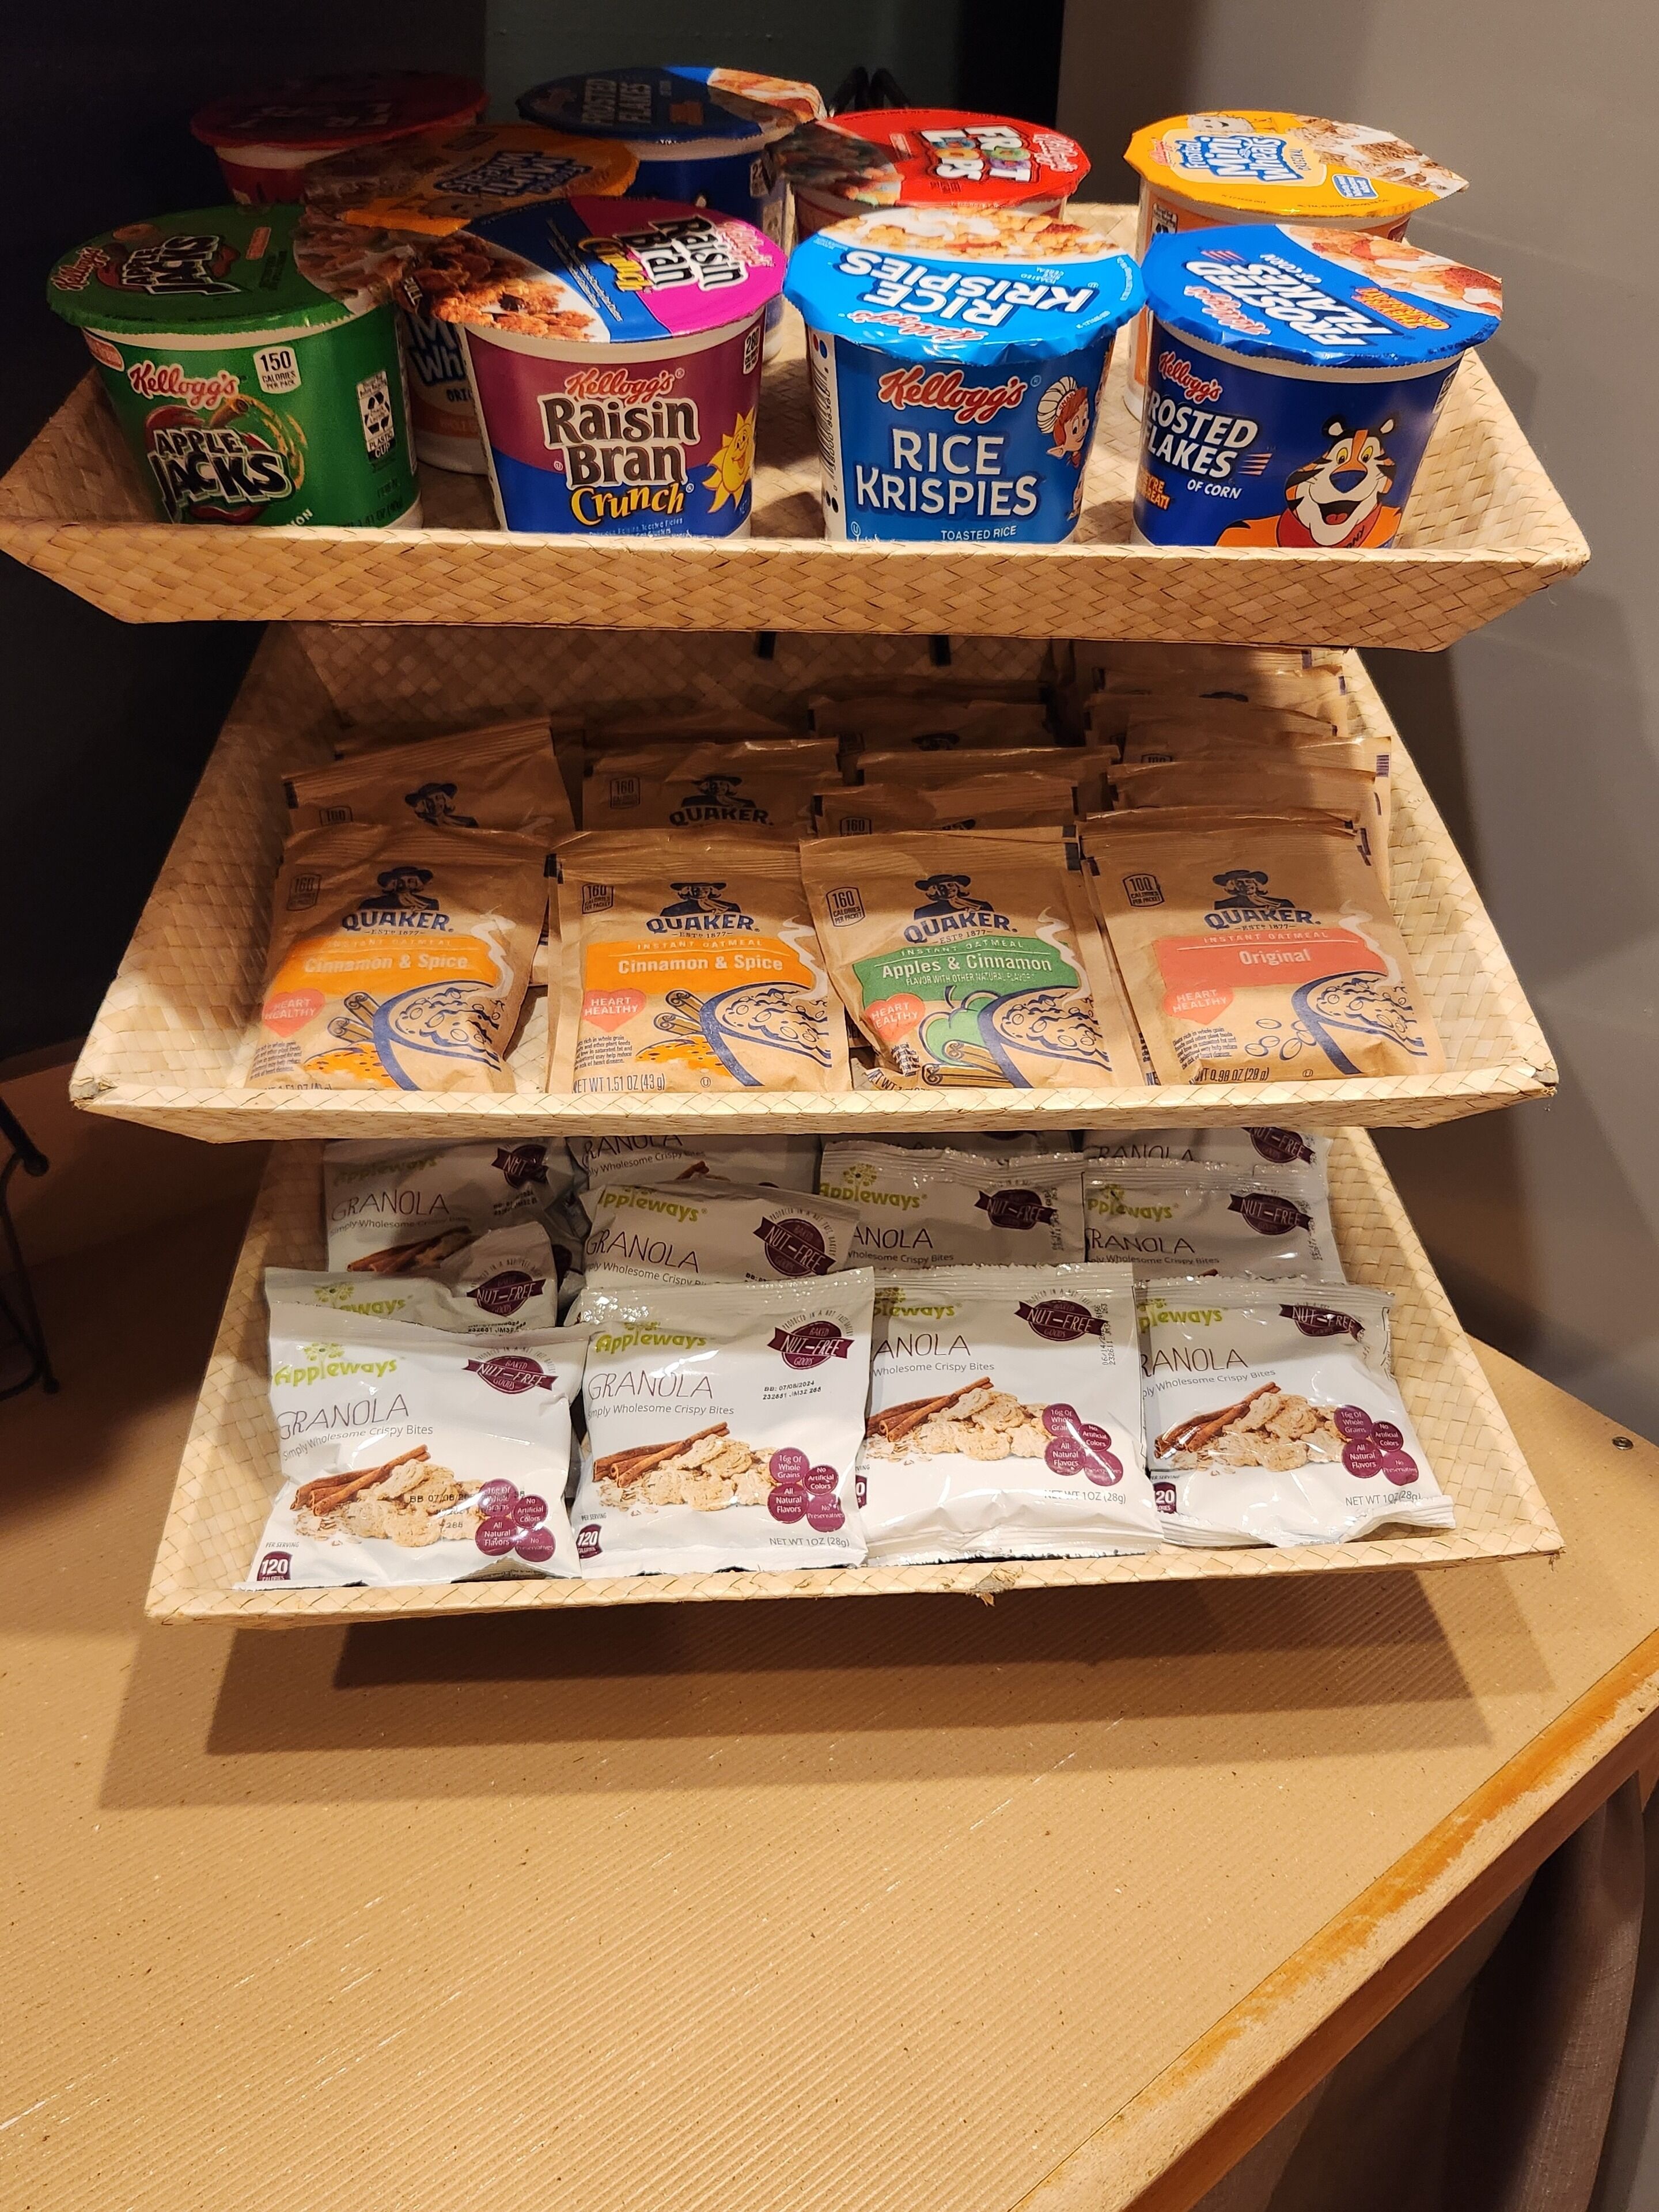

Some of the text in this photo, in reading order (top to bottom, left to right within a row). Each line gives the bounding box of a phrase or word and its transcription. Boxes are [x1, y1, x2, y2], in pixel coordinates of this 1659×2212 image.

[922, 130, 984, 181] LOOPS
[964, 124, 1032, 182] FROOT
[1202, 137, 1257, 176] Mini
[1248, 137, 1303, 181] Wheats
[614, 232, 696, 289] Bran
[654, 216, 747, 289] Raisin
[578, 238, 654, 291] Crunch
[840, 251, 1095, 312] KRISPIES
[864, 281, 1015, 327] RICE
[1186, 261, 1368, 346] FROSTED
[1231, 263, 1394, 335] FLAKES
[260, 351, 291, 373] 150
[129, 361, 238, 408] Kellogg's
[565, 368, 674, 404] Kellogg's
[881, 369, 1026, 423] Kellogg's
[541, 399, 697, 444] Raisin
[154, 427, 245, 455] APPLE
[374, 442, 391, 459] CUP
[893, 429, 1005, 475] RICE
[569, 446, 685, 486] Bran
[149, 449, 296, 524] JACKS
[856, 467, 1037, 516] KRISPIES
[1187, 479, 1242, 499] OF CORN
[571, 485, 684, 525] Crunch
[941, 525, 1017, 541] TOASTED RICE
[669, 808, 769, 827] QUAKER
[587, 884, 607, 898] 160
[1129, 876, 1152, 892] 100
[832, 891, 855, 908] 160
[833, 907, 861, 918] CALORIES
[835, 912, 862, 923] PER PACKET
[1204, 909, 1315, 930] QUAKER
[646, 914, 754, 934] QUAKER
[904, 911, 1010, 944] QUAKER
[637, 939, 763, 950] INSTANT OATMEAL
[1203, 931, 1330, 944] INSTANT OATMEAL
[304, 954, 469, 972] Cinnamon & Spice
[618, 954, 783, 974] Cinnamon & Spice
[882, 955, 1053, 979] Apples & Cinnamon
[1238, 948, 1312, 966] Original
[906, 976, 932, 986] FLAVOR
[933, 975, 951, 983] WITH
[952, 973, 974, 982] OTHER
[591, 997, 631, 1007] HEART
[1172, 997, 1228, 1014] HEALTHY
[1176, 989, 1217, 1003] HEART
[584, 1005, 639, 1017] HEALTHY
[871, 1002, 910, 1021] HEART
[875, 1011, 918, 1029] EALTHY
[572, 1078, 588, 1094] NET
[589, 1077, 604, 1092] WT
[607, 1075, 624, 1092] 1.51
[627, 1075, 639, 1090] OZ
[641, 1074, 655, 1092] (43
[1210, 1069, 1230, 1082] 0.98
[1232, 1068, 1245, 1081] OZ
[1245, 1067, 1259, 1081] (28
[332, 1188, 450, 1222] GRANOLA
[1240, 1199, 1301, 1226] NUT-FREE
[853, 1226, 934, 1249] ANOLA
[586, 1229, 699, 1273] GRANOLA
[603, 1262, 660, 1281] Wholesome
[1027, 1309, 1095, 1333] NUT-FREE
[1044, 1328, 1066, 1338] GOODS
[596, 1333, 706, 1354] Appleways
[780, 1334, 844, 1356] NUT-FREE
[505, 1360, 528, 1370] BAKED
[794, 1356, 814, 1366] GOODS
[872, 1362, 995, 1377] Wholesome Crispy Bites
[272, 1358, 398, 1388] Appleways
[477, 1363, 547, 1386] NUT-FREE
[588, 1372, 713, 1400] GRANOLA
[276, 1393, 410, 1440] GRANOLA
[613, 1403, 672, 1415] Wholesome
[675, 1403, 707, 1416] Crispy
[709, 1404, 734, 1415] Bites
[1051, 1409, 1063, 1417] 16g
[282, 1423, 434, 1461] Simply Wholesome Crispy Bites
[779, 1455, 791, 1464] 16g
[1349, 1452, 1376, 1460] Natural
[1351, 1461, 1377, 1469] Flavors
[1103, 1492, 1127, 1505] (28g)
[1156, 1489, 1175, 1504] 20
[1345, 1497, 1364, 1506] NET
[1365, 1495, 1381, 1505] WT
[578, 1531, 599, 1546] 120
[770, 1537, 788, 1546] NET
[789, 1537, 804, 1546] WT
[827, 1537, 850, 1547] (28g)
[262, 1558, 289, 1575] 120
